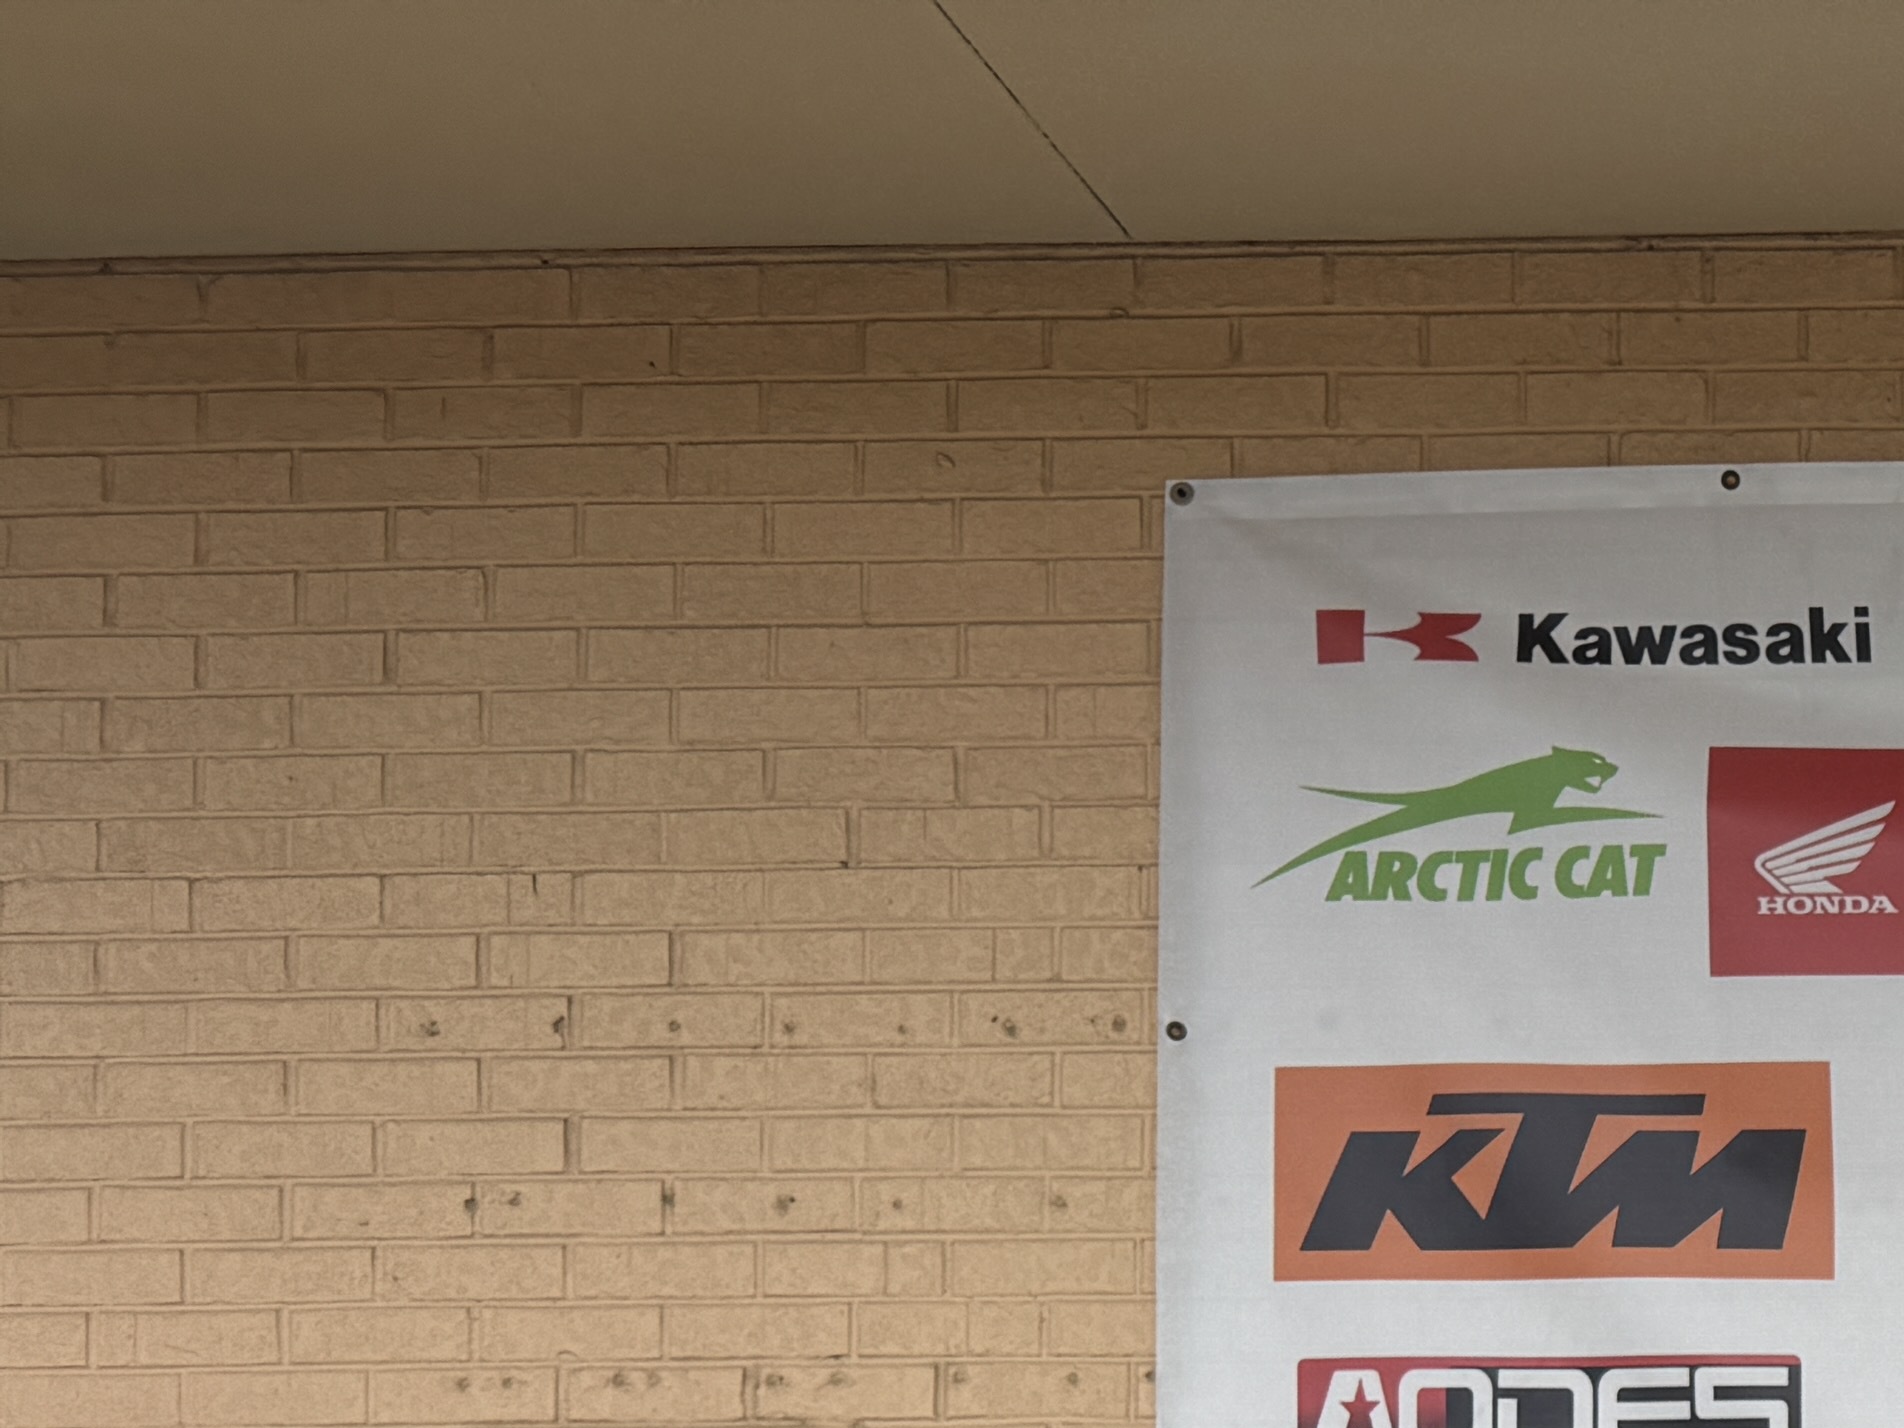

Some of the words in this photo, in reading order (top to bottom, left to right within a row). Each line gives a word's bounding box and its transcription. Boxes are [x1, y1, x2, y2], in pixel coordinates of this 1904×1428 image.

[1517, 606, 1873, 666] Kawasaki
[1324, 846, 1544, 903] ARCTIC
[1553, 843, 1668, 901] CAT
[1757, 894, 1898, 916] HONDA
[1299, 1092, 1807, 1252] KTM
